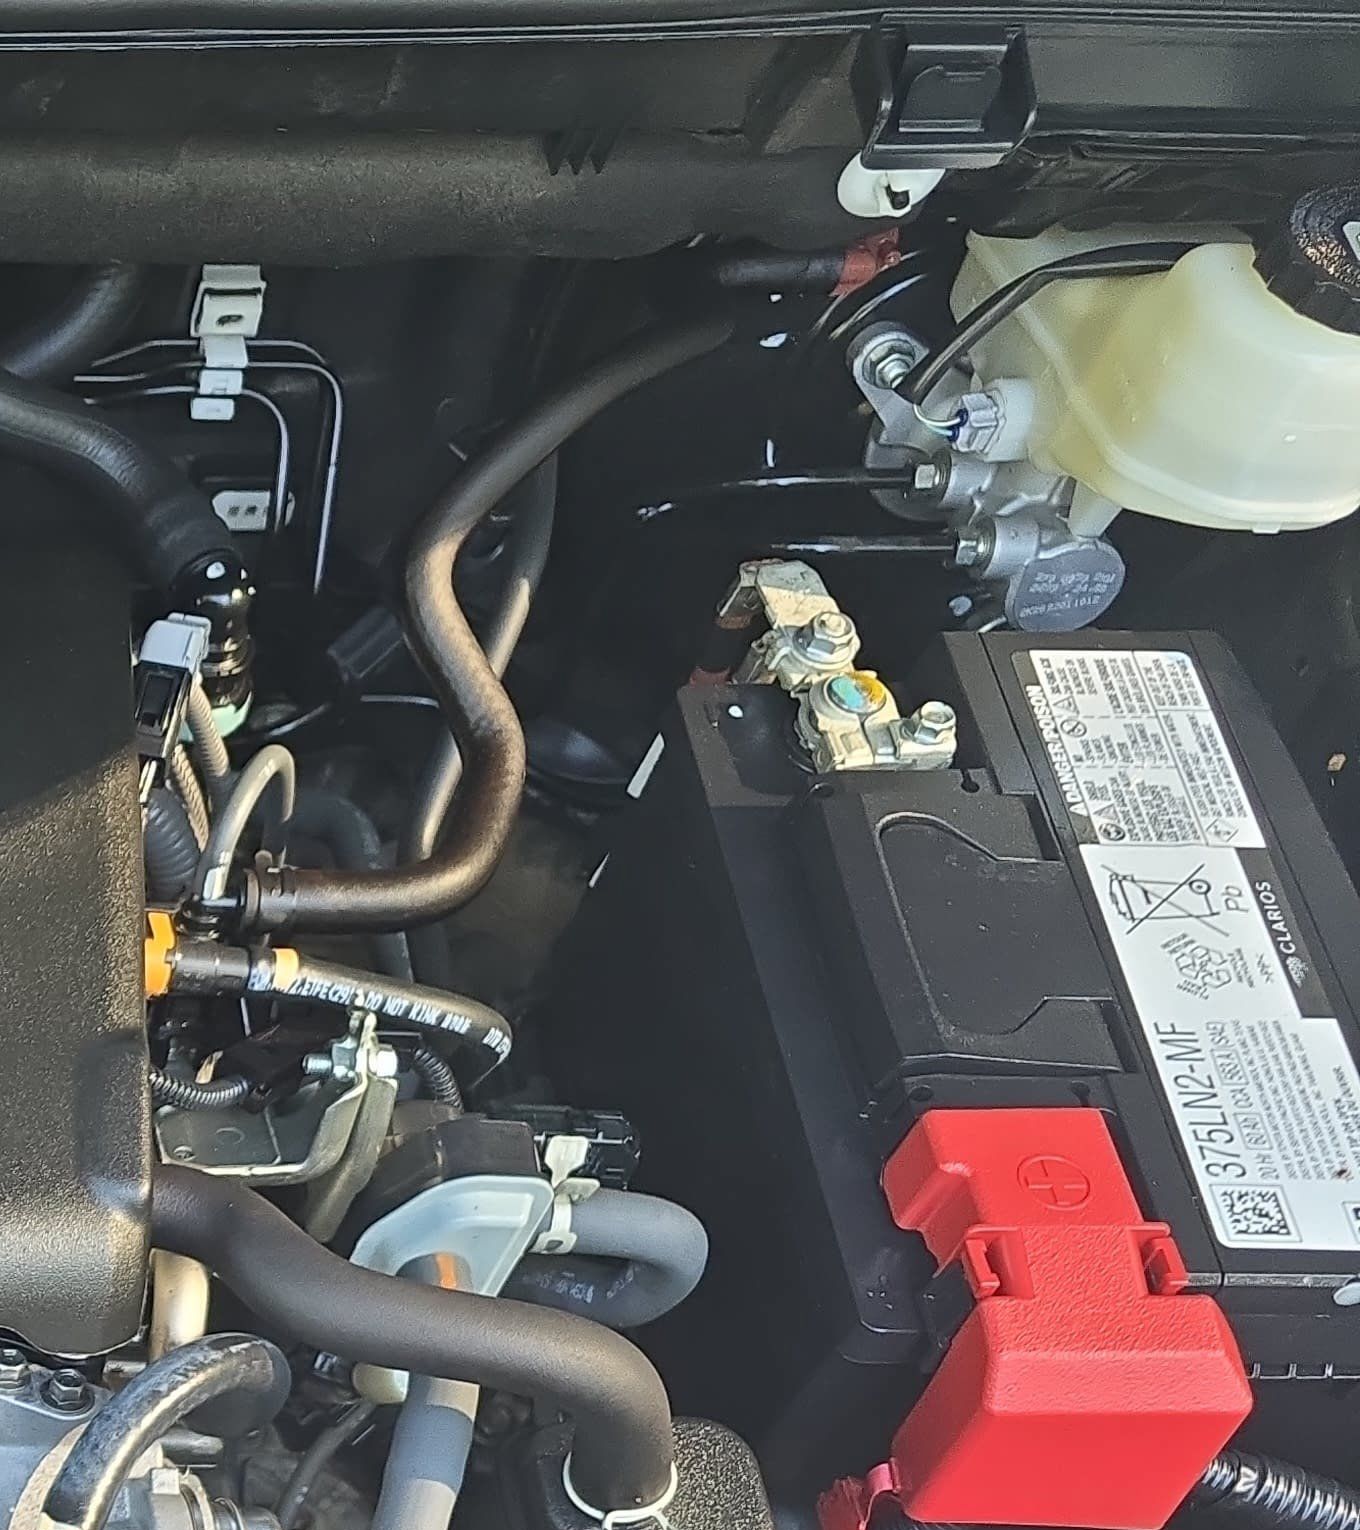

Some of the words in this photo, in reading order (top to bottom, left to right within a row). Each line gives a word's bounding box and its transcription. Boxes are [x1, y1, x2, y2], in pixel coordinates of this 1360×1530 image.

[1221, 885, 1249, 913] Pb
[1255, 881, 1296, 954] CLARIOS
[1153, 1022, 1247, 1178] 375LN2-MF
